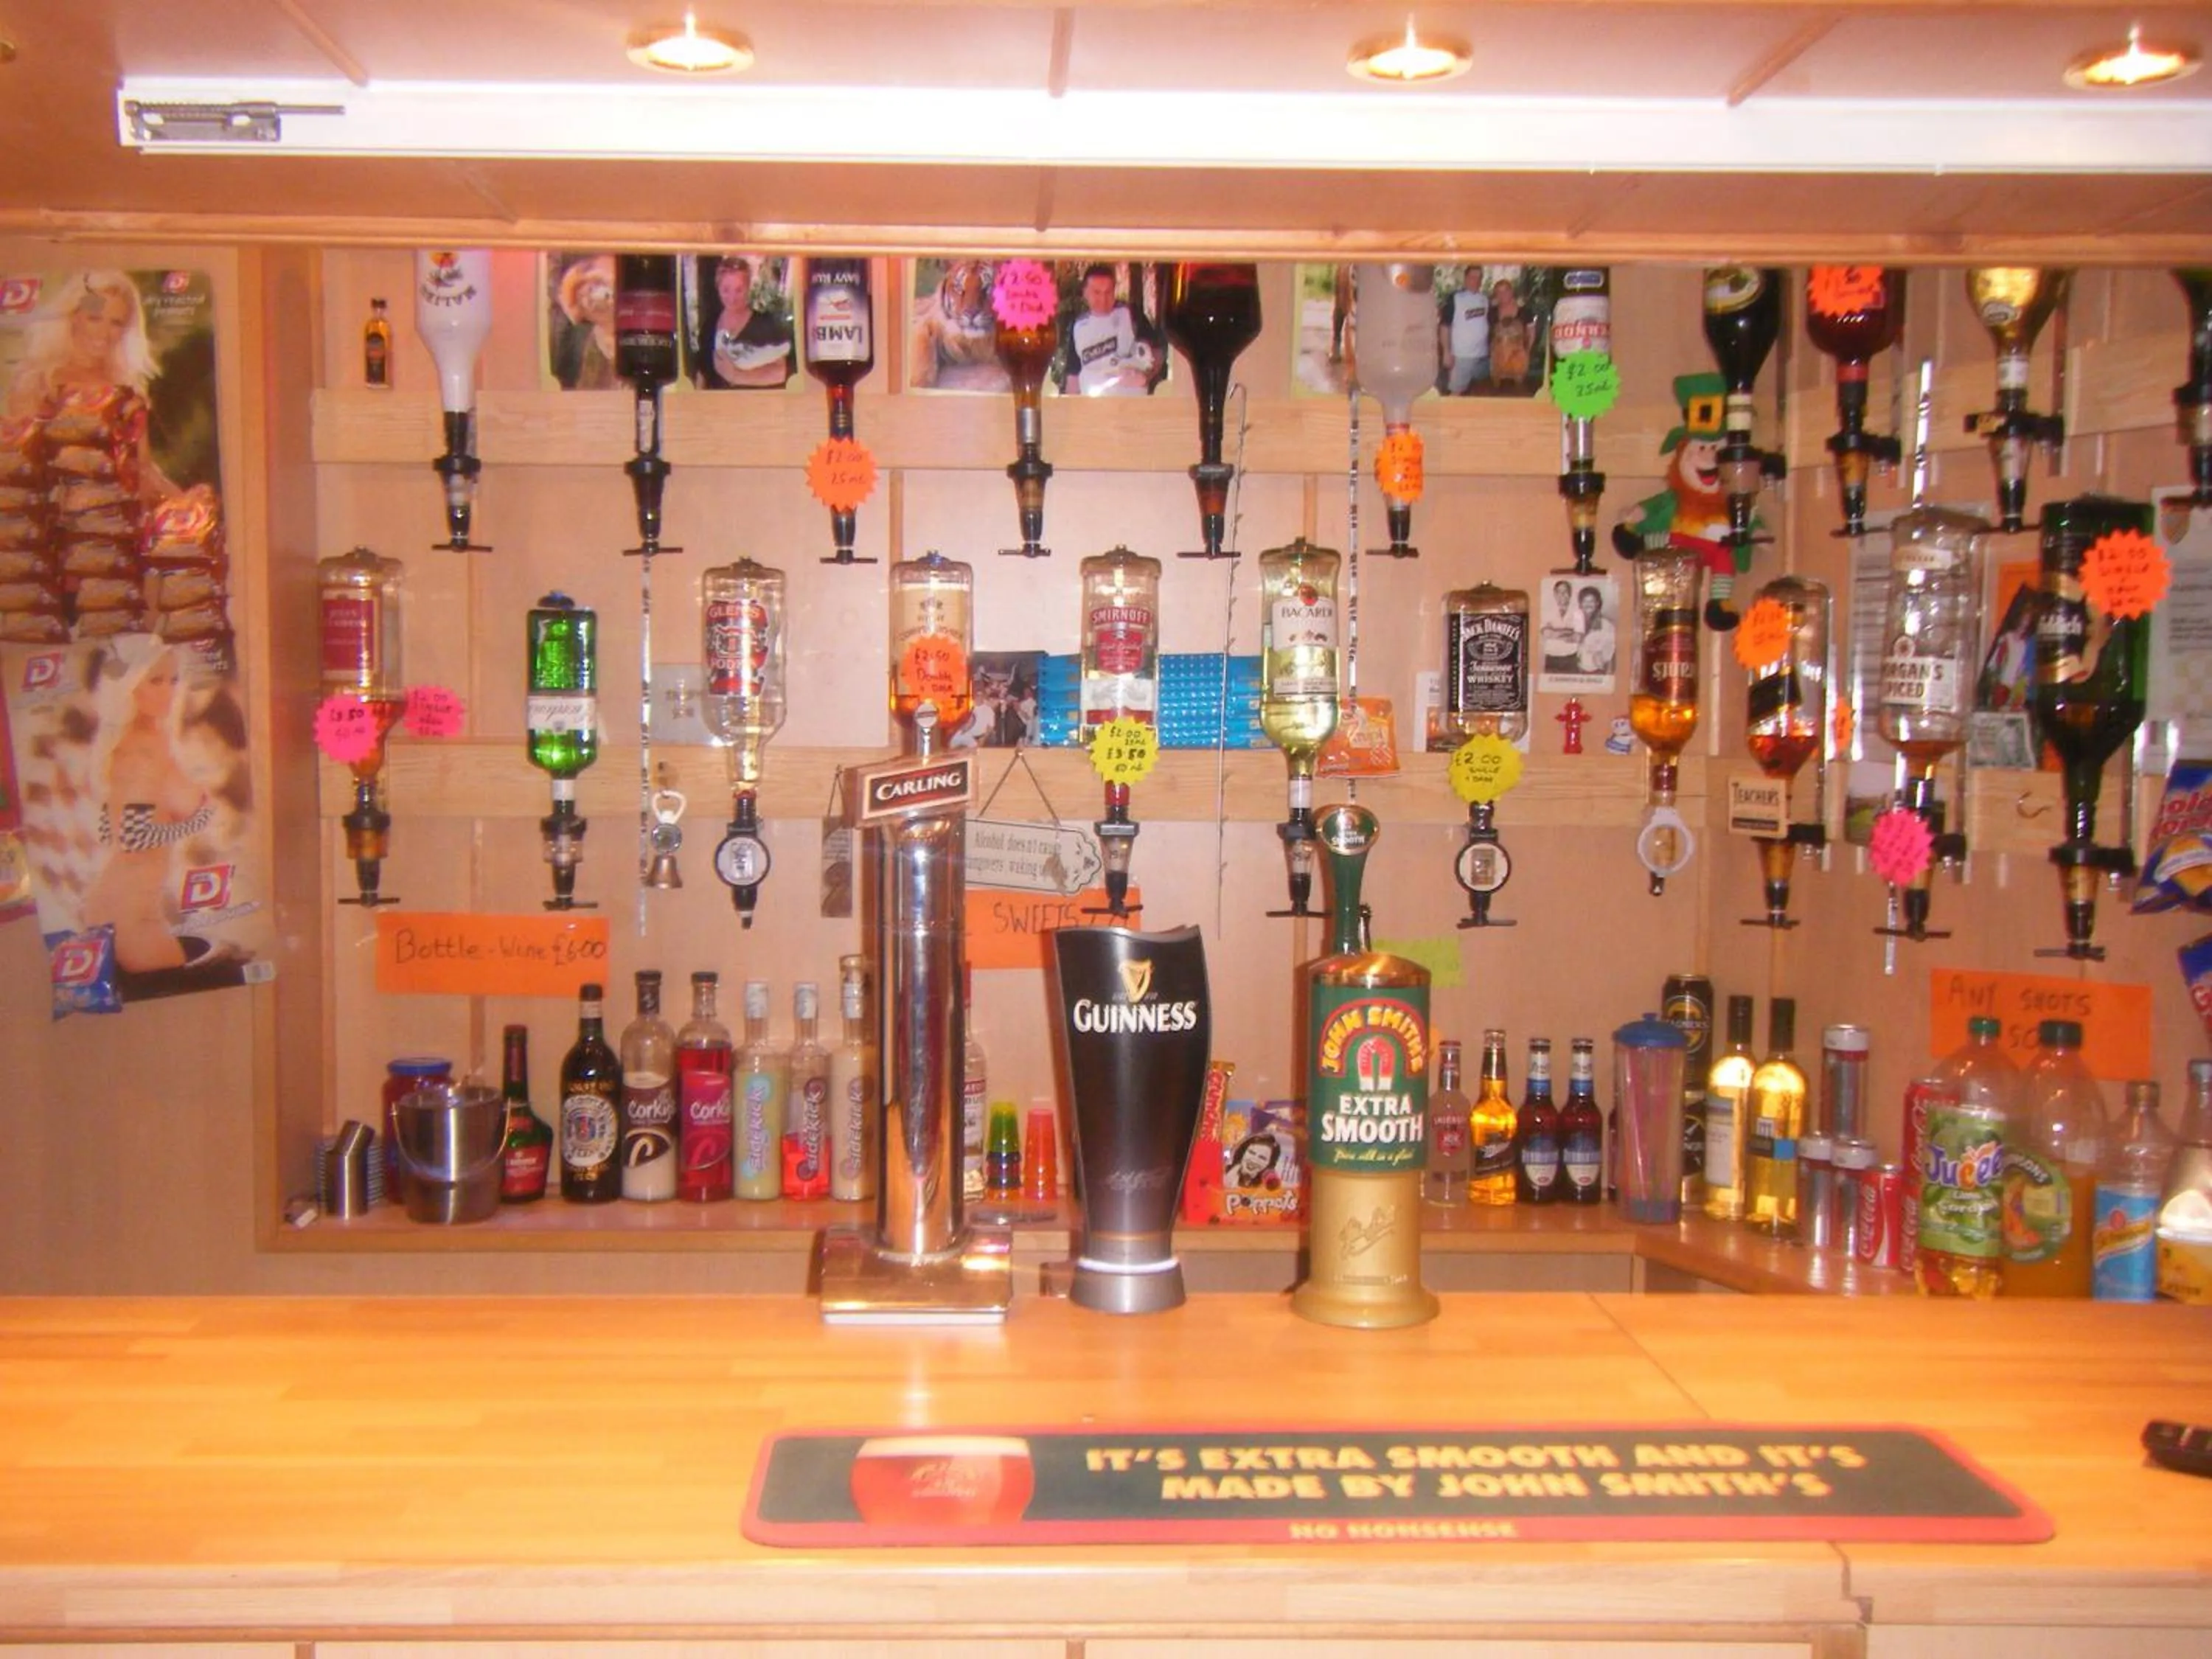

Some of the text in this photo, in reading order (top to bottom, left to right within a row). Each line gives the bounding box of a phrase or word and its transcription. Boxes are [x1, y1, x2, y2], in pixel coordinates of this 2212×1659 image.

[1093, 609, 1148, 625] SMIRNOFF
[876, 771, 962, 801] CARLING
[992, 901, 1080, 935] SWEETS
[395, 928, 481, 964] Bottle
[1073, 998, 1198, 1033] GUINNESS
[2020, 987, 2091, 1017] SHOTS
[1321, 1005, 1427, 1074] JOHN SMITH'S
[1339, 1093, 1413, 1116] EXTRA
[1321, 1109, 1425, 1144] SMOOTH
[1924, 1141, 2004, 1189] Jucee
[1085, 1444, 1870, 1472] IT'S EXTRA SMOOTH AND IT'S
[1161, 1472, 1834, 1500] MADE BY JOHN SMITH'S
[1289, 1520, 1519, 1540] NO NONSENSE
